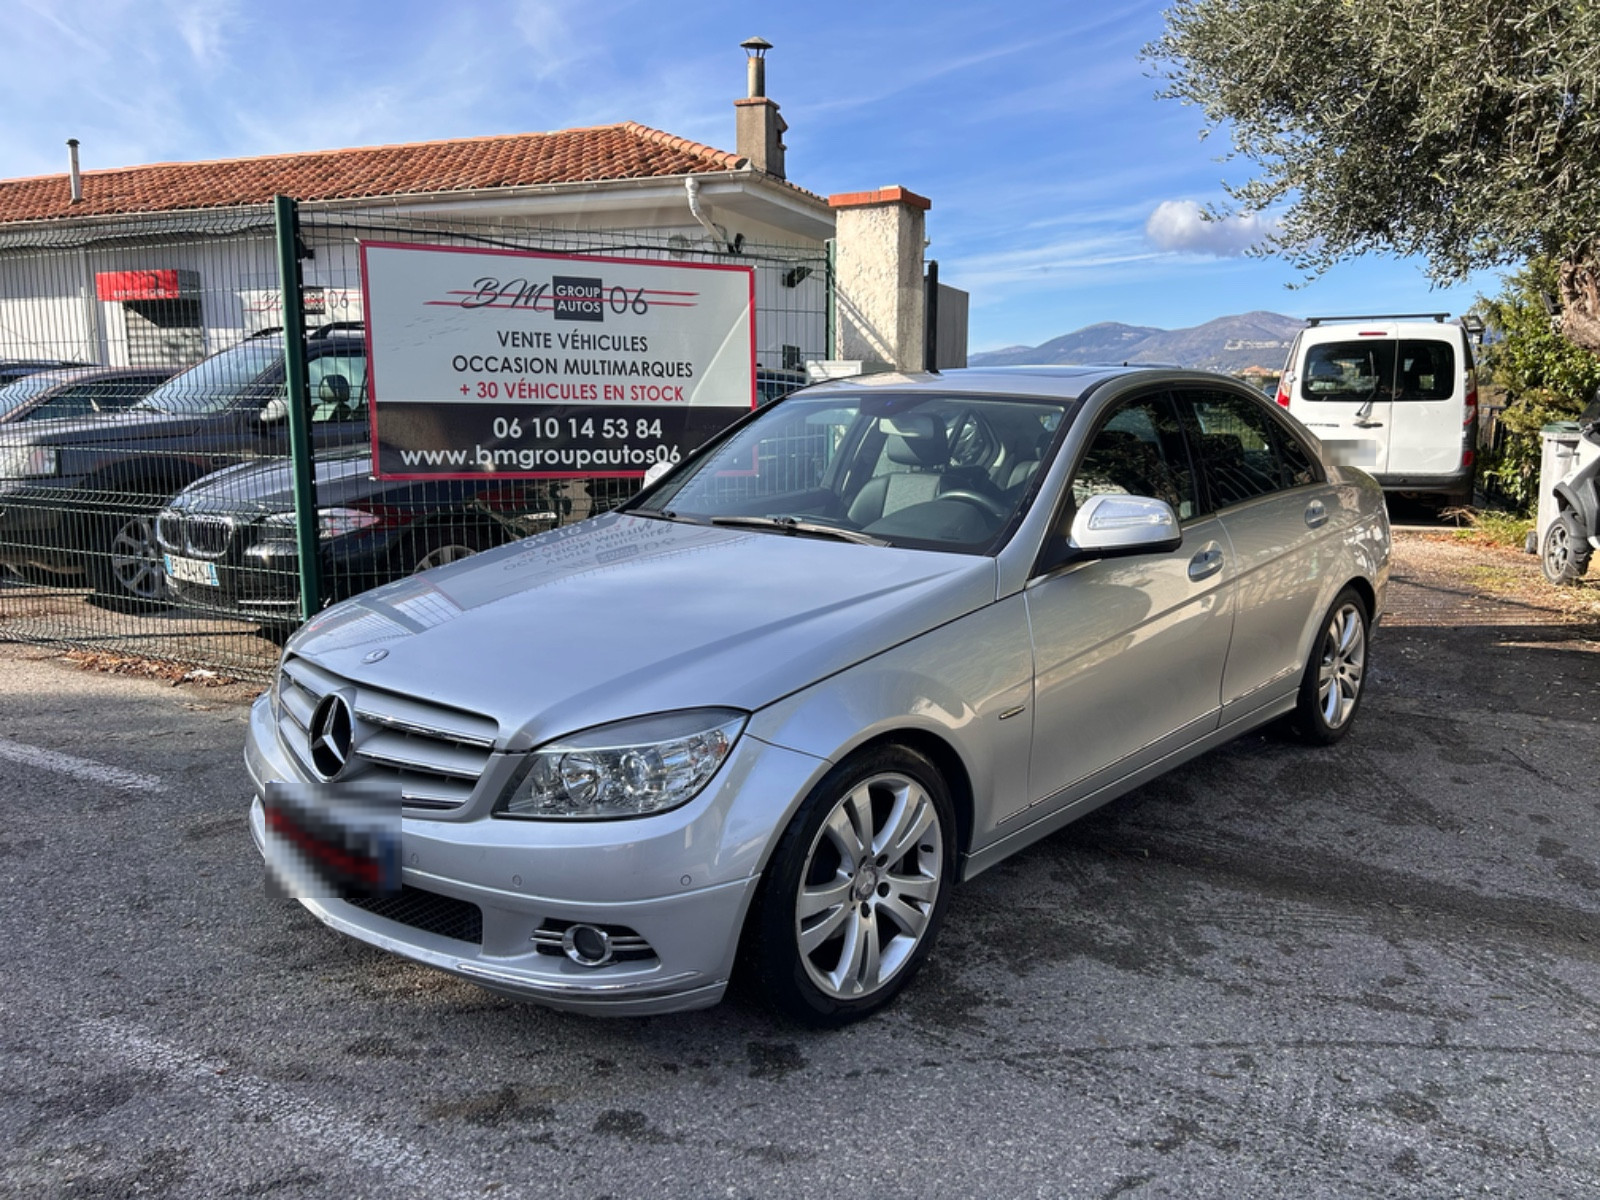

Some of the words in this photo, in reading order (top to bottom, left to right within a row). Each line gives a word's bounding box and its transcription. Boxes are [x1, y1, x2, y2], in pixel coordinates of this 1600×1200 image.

[461, 277, 550, 312] BM
[556, 285, 601, 298] GROUP
[610, 286, 648, 315] 06
[557, 300, 601, 313] AUTOS
[496, 330, 552, 349] VENTE
[558, 328, 649, 352] VÉHICULES
[452, 354, 558, 375] OCCASION
[564, 358, 693, 378] MULTIMARQUES
[460, 383, 471, 394] +
[477, 381, 498, 399] 30
[504, 377, 598, 401] VÉHICULES
[604, 384, 625, 400] EN
[631, 385, 684, 402] STOCK
[493, 417, 522, 439] 06
[532, 417, 560, 439] 10
[568, 418, 595, 439] 14
[602, 418, 628, 439] 53
[635, 418, 663, 439] 84
